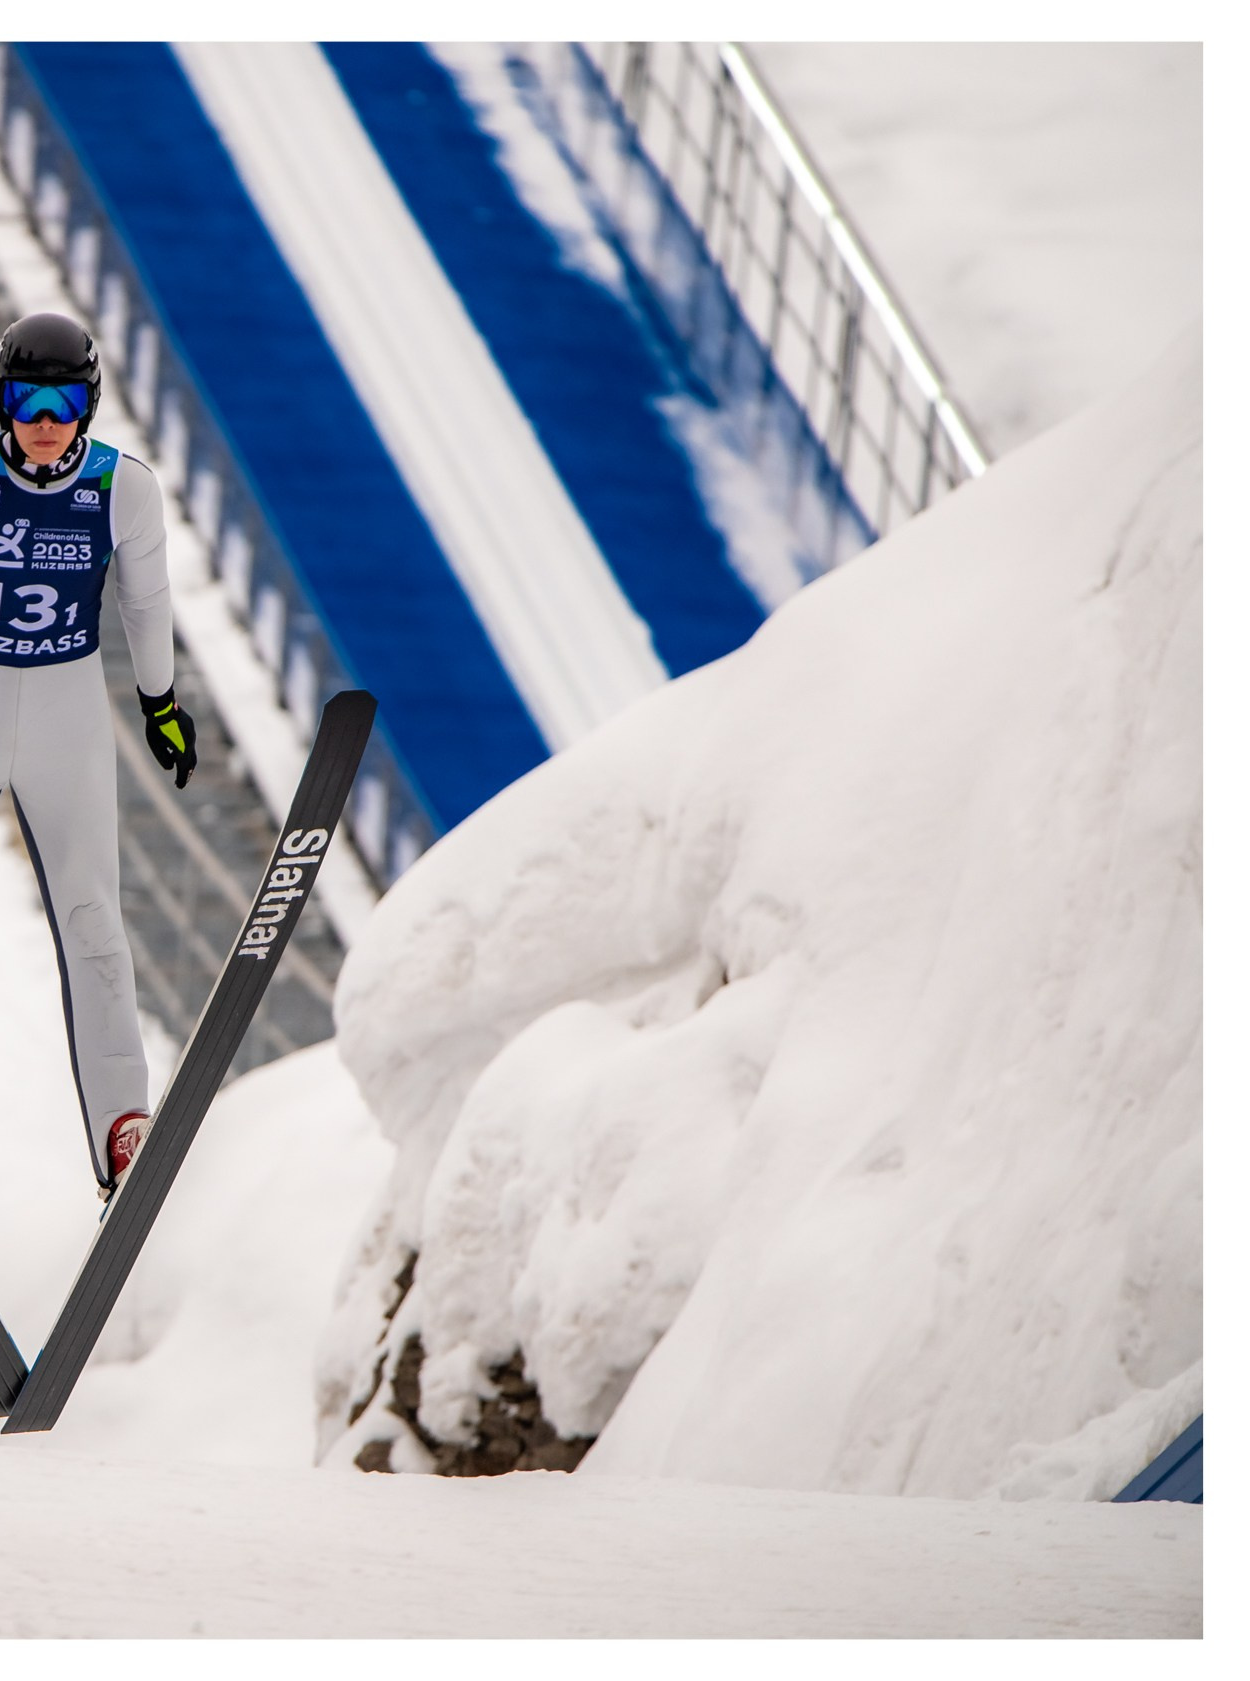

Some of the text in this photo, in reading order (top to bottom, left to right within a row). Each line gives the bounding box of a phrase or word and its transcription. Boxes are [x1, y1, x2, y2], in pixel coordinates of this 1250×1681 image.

[33, 532, 66, 541] Children
[74, 534, 91, 542] Asia
[32, 543, 92, 560] 2023
[31, 562, 92, 570] KUZBASS
[237, 828, 329, 960] Slatnar
